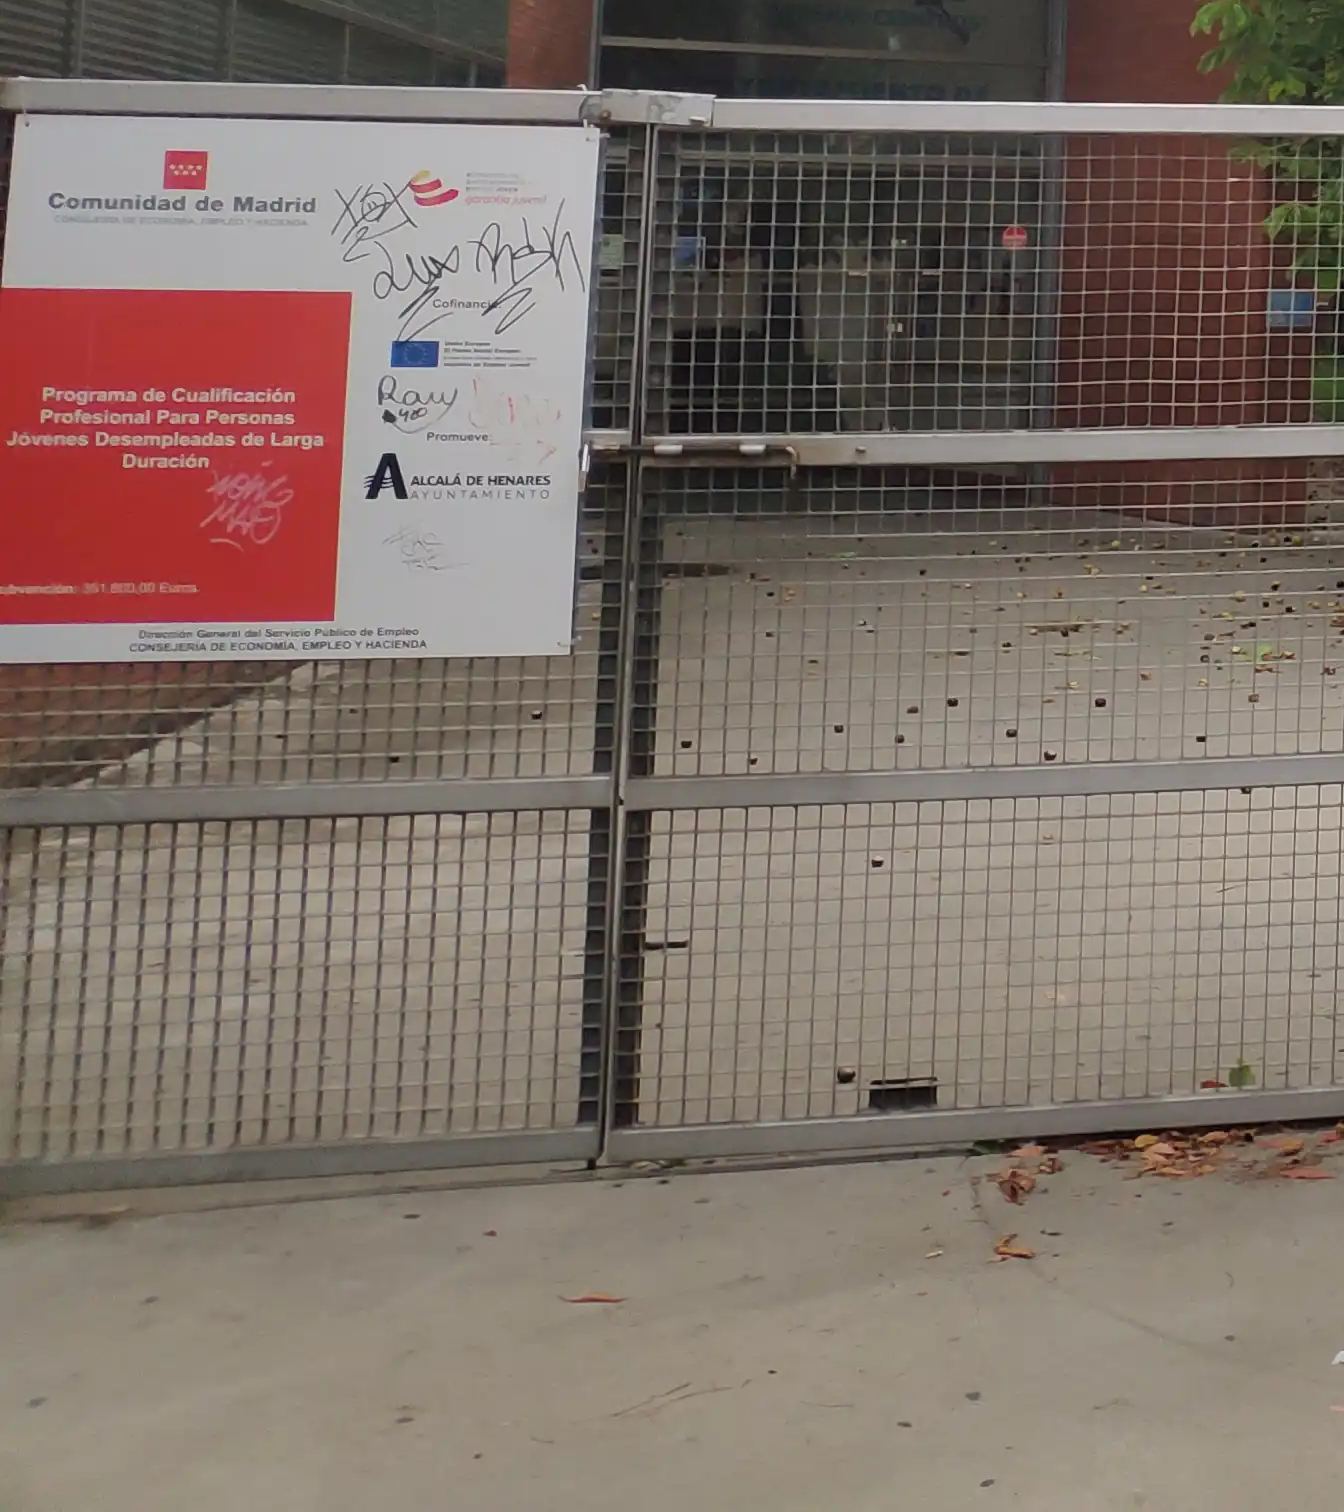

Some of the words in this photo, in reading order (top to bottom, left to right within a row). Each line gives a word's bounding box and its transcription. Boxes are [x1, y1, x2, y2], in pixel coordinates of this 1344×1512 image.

[48, 192, 187, 211] Comunidad
[195, 195, 224, 212] de
[233, 195, 317, 214] Madrid
[41, 386, 138, 406] Programa
[142, 387, 166, 403] de
[171, 386, 296, 404] Cualificación
[40, 409, 151, 425] Profesional
[156, 410, 200, 425] Para
[205, 409, 296, 425] Personas
[6, 431, 89, 447] Jóvenes
[95, 431, 237, 449] Desempleadas
[241, 432, 266, 447] de
[269, 432, 325, 450] Larga
[121, 452, 211, 469] Duración
[410, 472, 462, 486] ALCALÁ
[466, 475, 484, 486] DE
[487, 474, 551, 486] HENARES
[409, 489, 551, 500] AYUNTAMIENTO
[138, 629, 193, 639] Dirección
[196, 629, 241, 638] General
[244, 628, 261, 638] del
[265, 628, 311, 638] Servicio
[360, 627, 374, 637] de
[376, 627, 420, 638] Empleo
[209, 642, 227, 652] DE
[302, 639, 351, 651] EMPLEO
[354, 639, 363, 650] Y
[365, 639, 428, 650] HACIENDA
